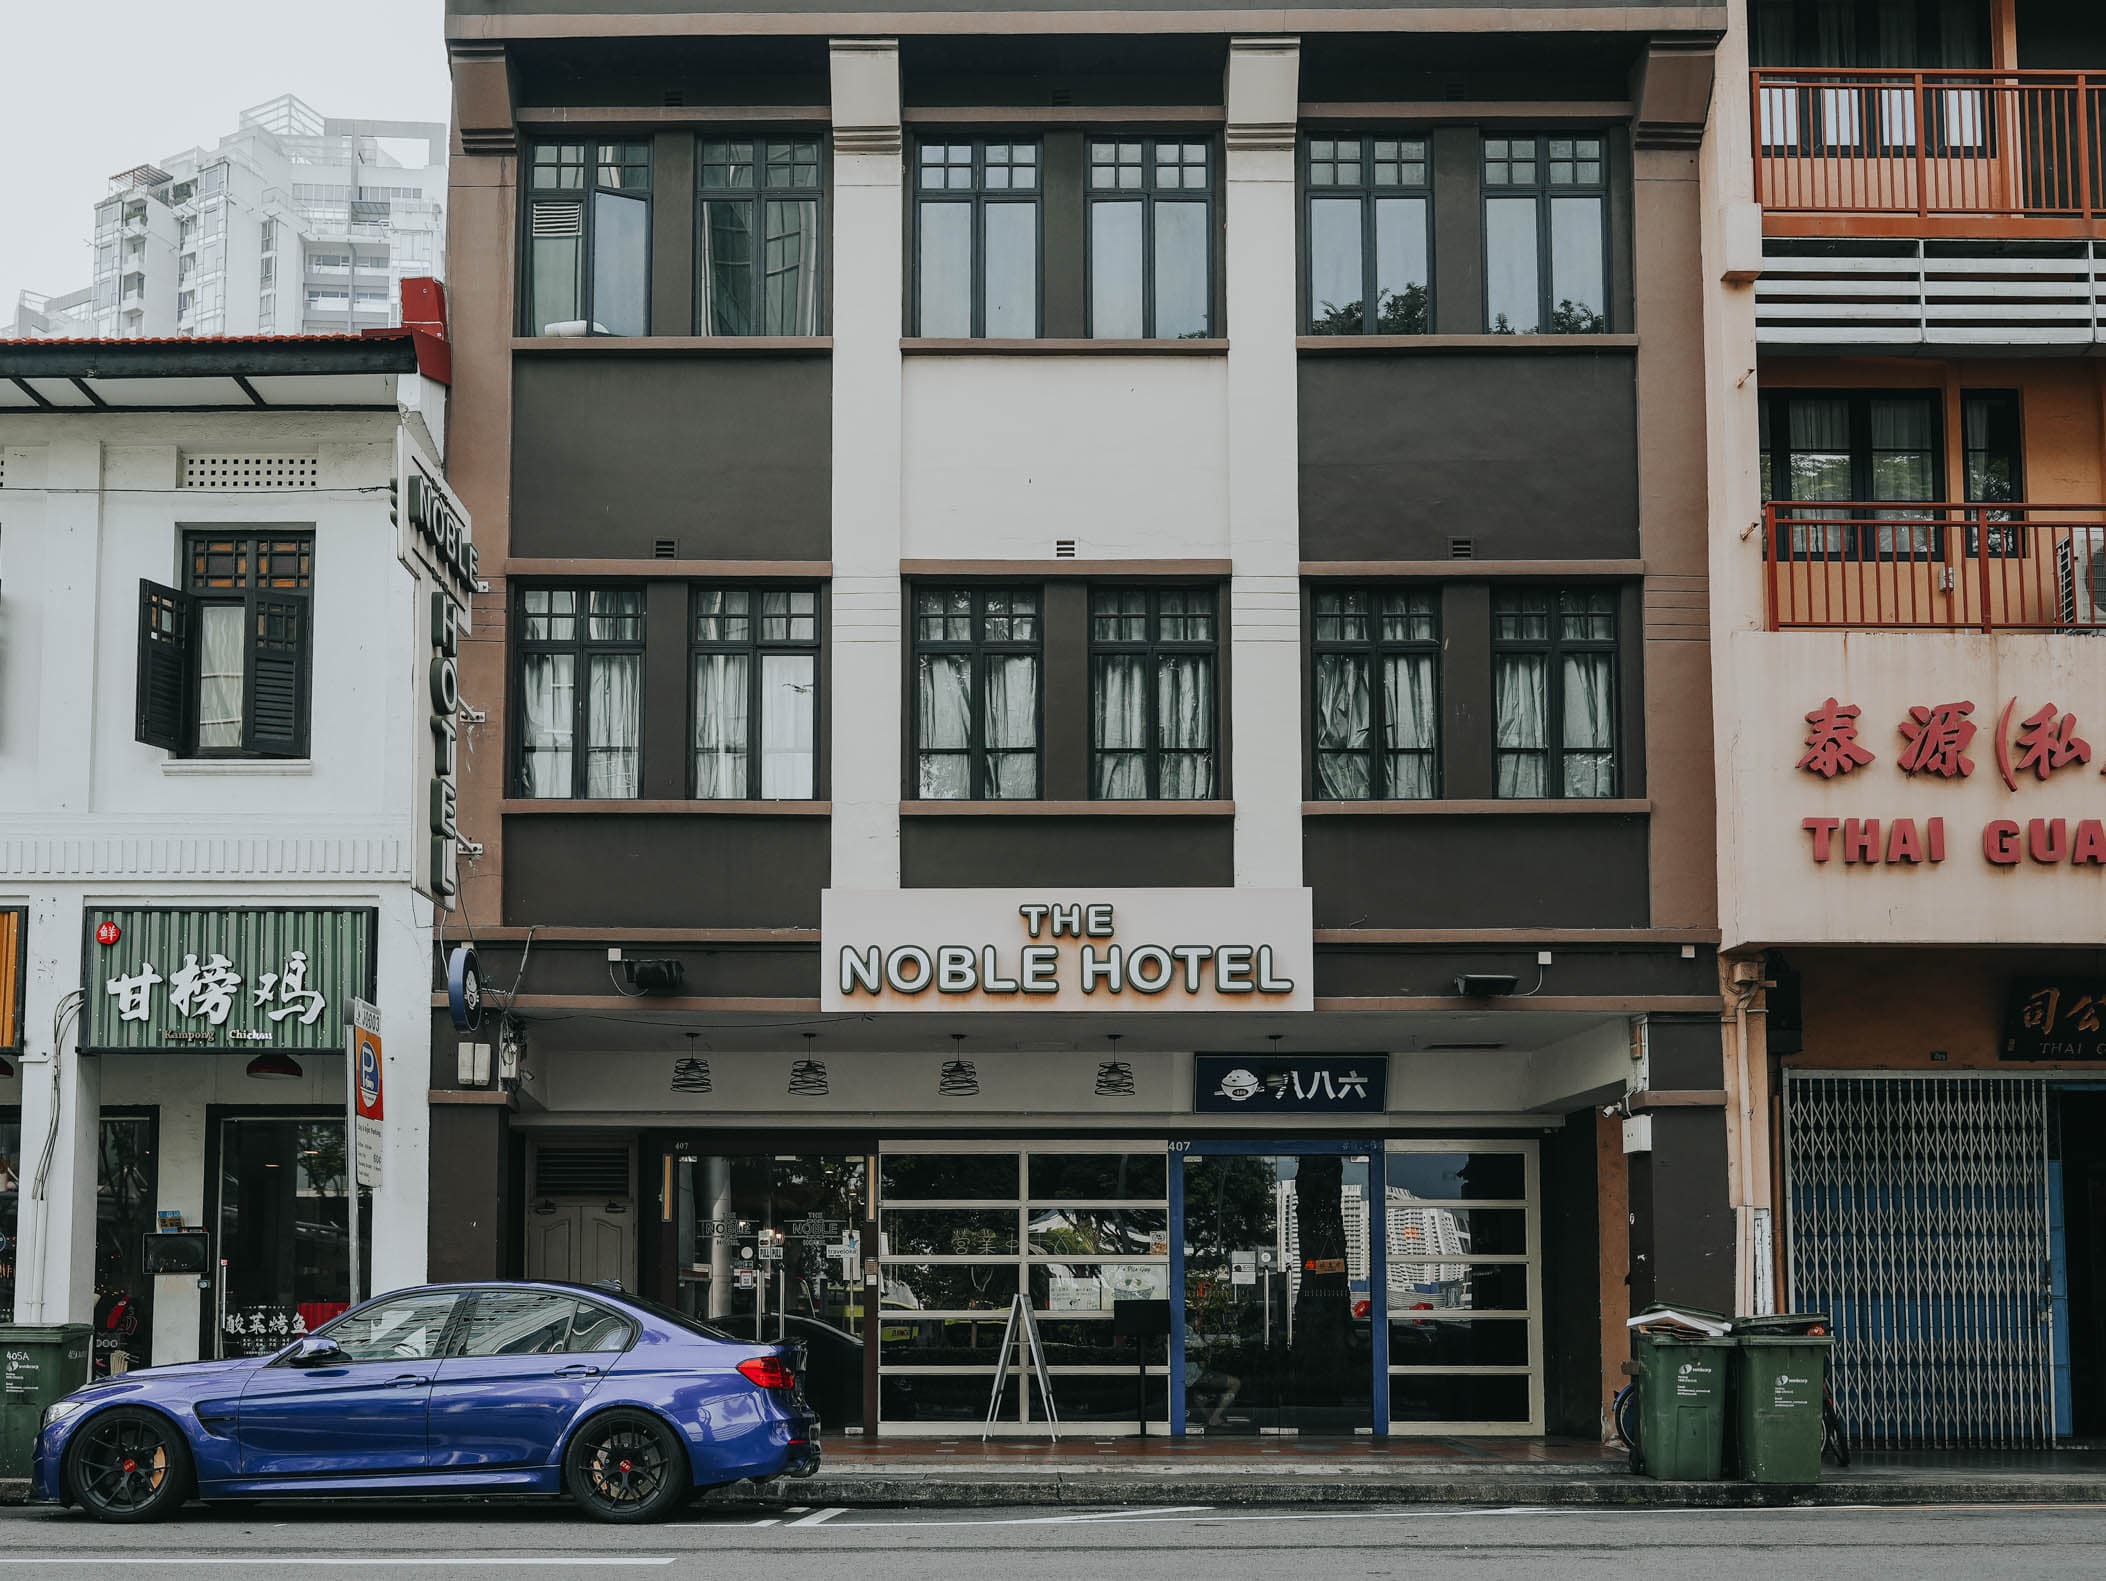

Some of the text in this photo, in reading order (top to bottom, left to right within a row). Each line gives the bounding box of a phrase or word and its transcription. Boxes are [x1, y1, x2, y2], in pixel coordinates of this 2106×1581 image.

[408, 475, 478, 593] NOBLE
[430, 592, 458, 897] HOTEL
[1795, 697, 2106, 792] 泰源(私
[1803, 817, 2106, 865] THAI GUA
[1018, 903, 1115, 938] THE
[839, 943, 1295, 996] NOBLE HOTEL
[106, 950, 327, 1026] 甘榜鸡
[163, 1030, 215, 1042] Kampong
[2039, 1042, 2084, 1055] THAI
[674, 1142, 689, 1150] 407
[1168, 1141, 1191, 1152] 407
[792, 1222, 838, 1235] NOBLE
[828, 1247, 857, 1255] traveloka
[225, 1311, 309, 1335] 酸菜烤鱼
[6, 1350, 30, 1361] 405A
